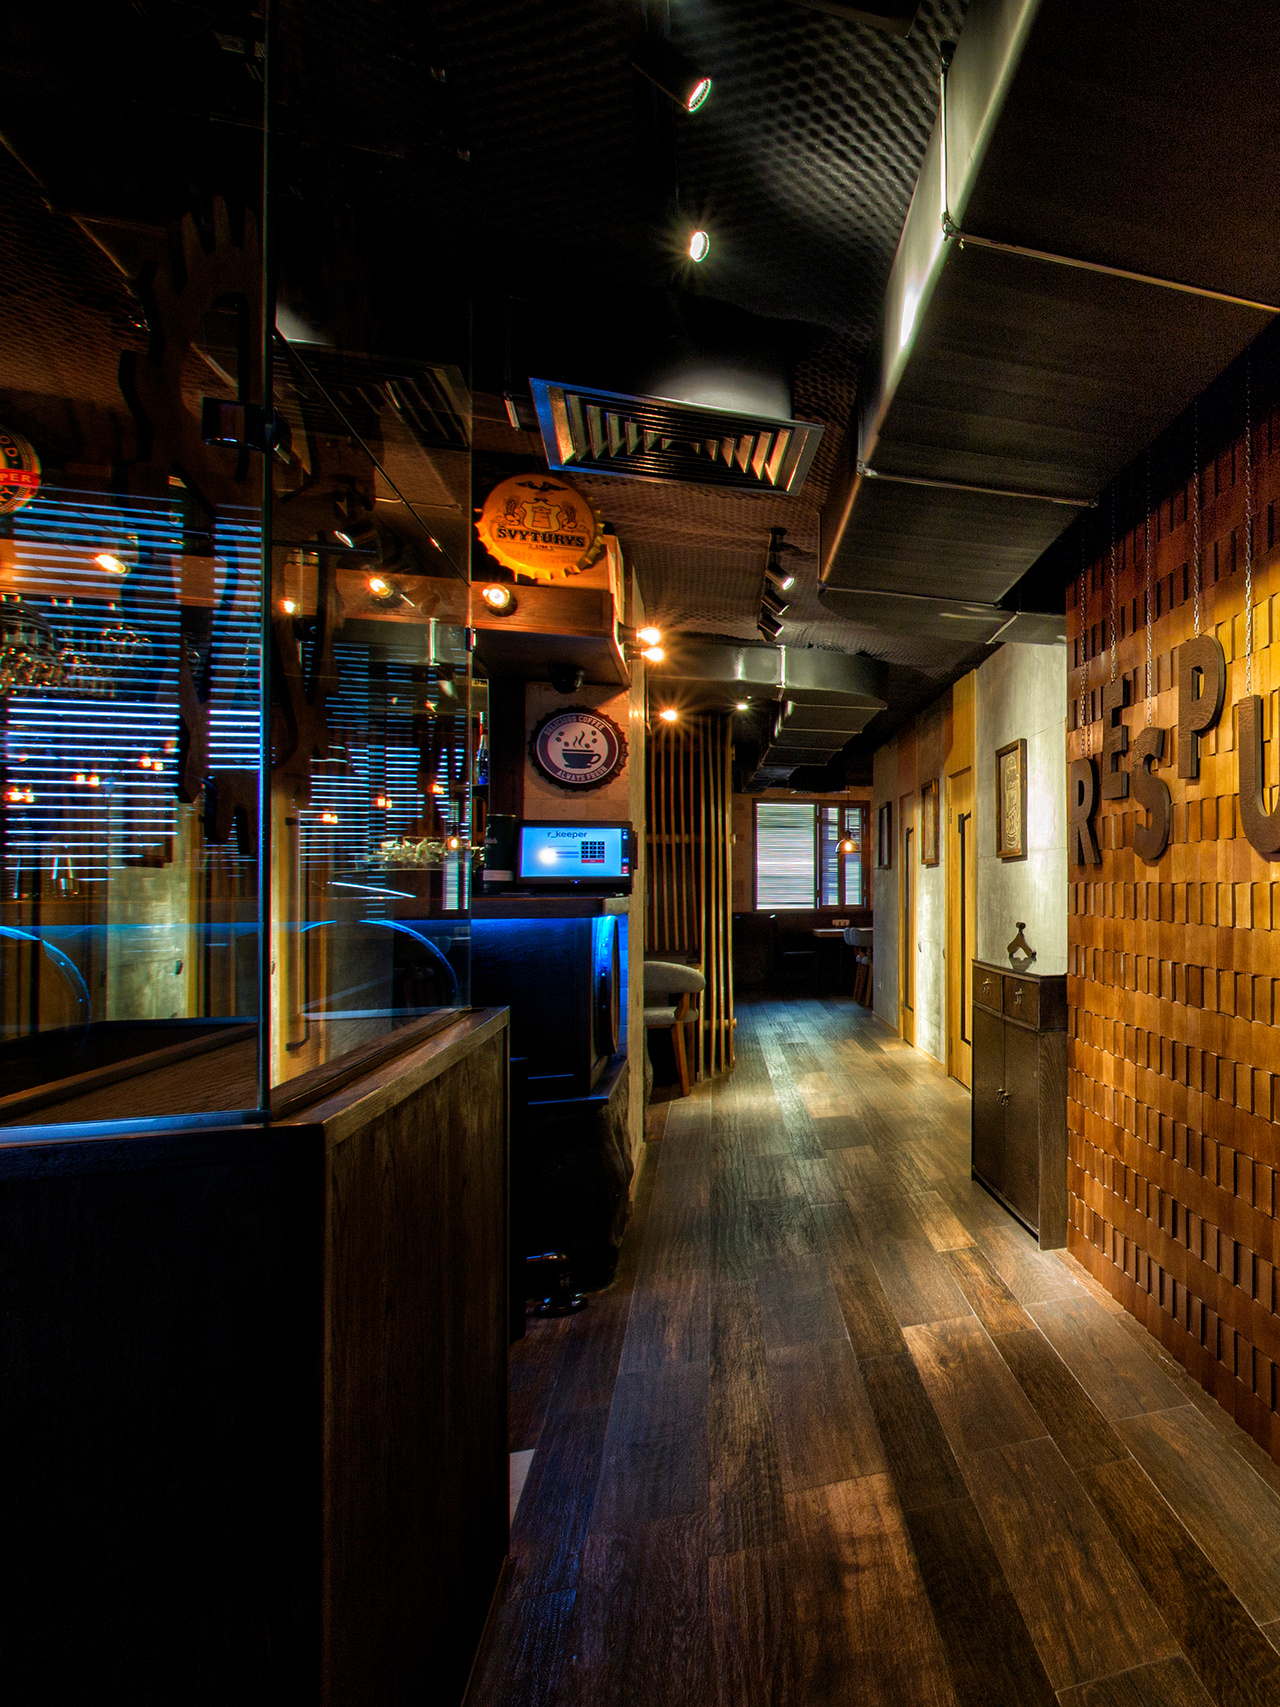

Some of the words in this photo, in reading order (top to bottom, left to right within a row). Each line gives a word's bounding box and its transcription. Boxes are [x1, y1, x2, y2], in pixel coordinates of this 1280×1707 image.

[543, 715, 578, 736] DELICIOUS
[578, 715, 606, 731] COFFEE
[556, 770, 586, 781] ALWAYS
[586, 765, 608, 780] FRESH
[547, 830, 588, 839] r_keeper
